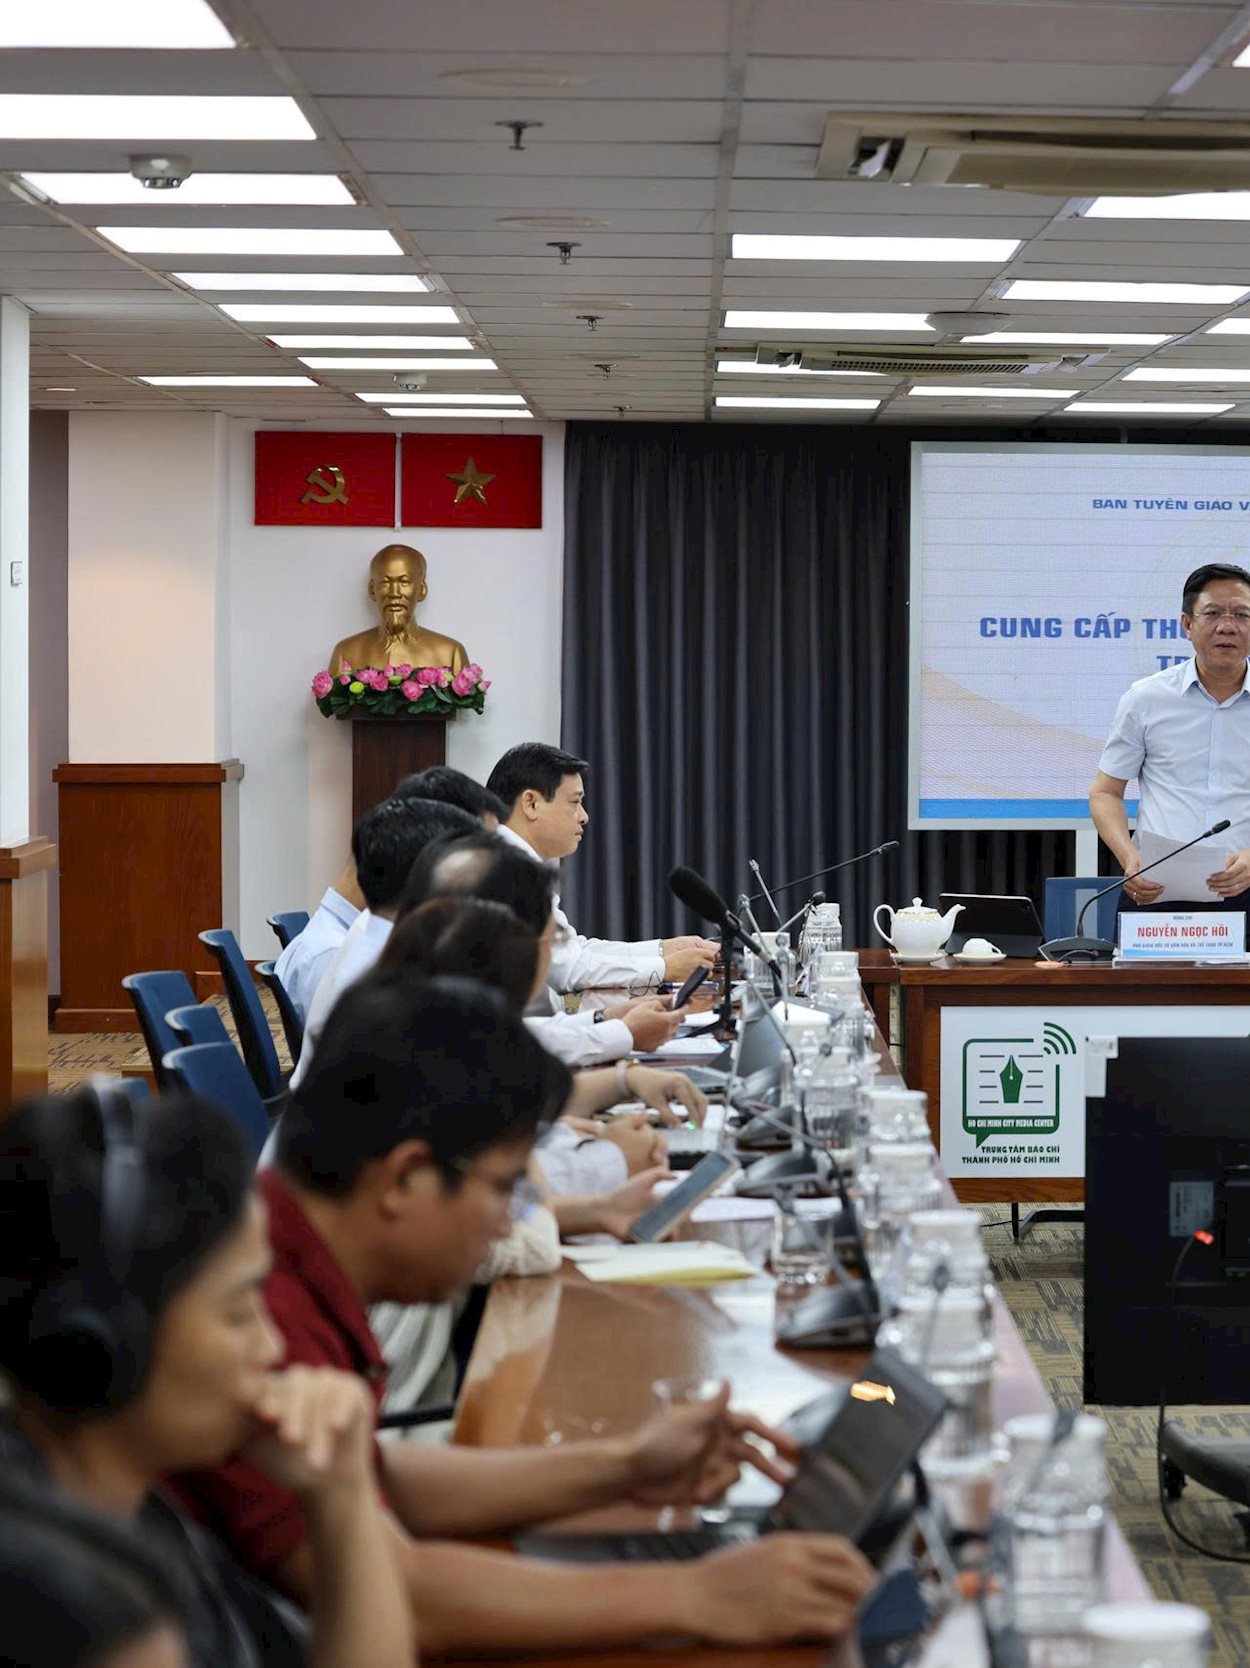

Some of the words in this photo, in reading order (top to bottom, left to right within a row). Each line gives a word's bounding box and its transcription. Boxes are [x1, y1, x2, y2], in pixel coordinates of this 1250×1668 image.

[1092, 499, 1127, 509] BAN
[1133, 497, 1188, 510] TUYÊN
[1194, 498, 1233, 511] GIÁO
[979, 616, 1062, 638] CUNG
[1074, 611, 1131, 639] CẤP
[1181, 926, 1209, 938] NGỌC
